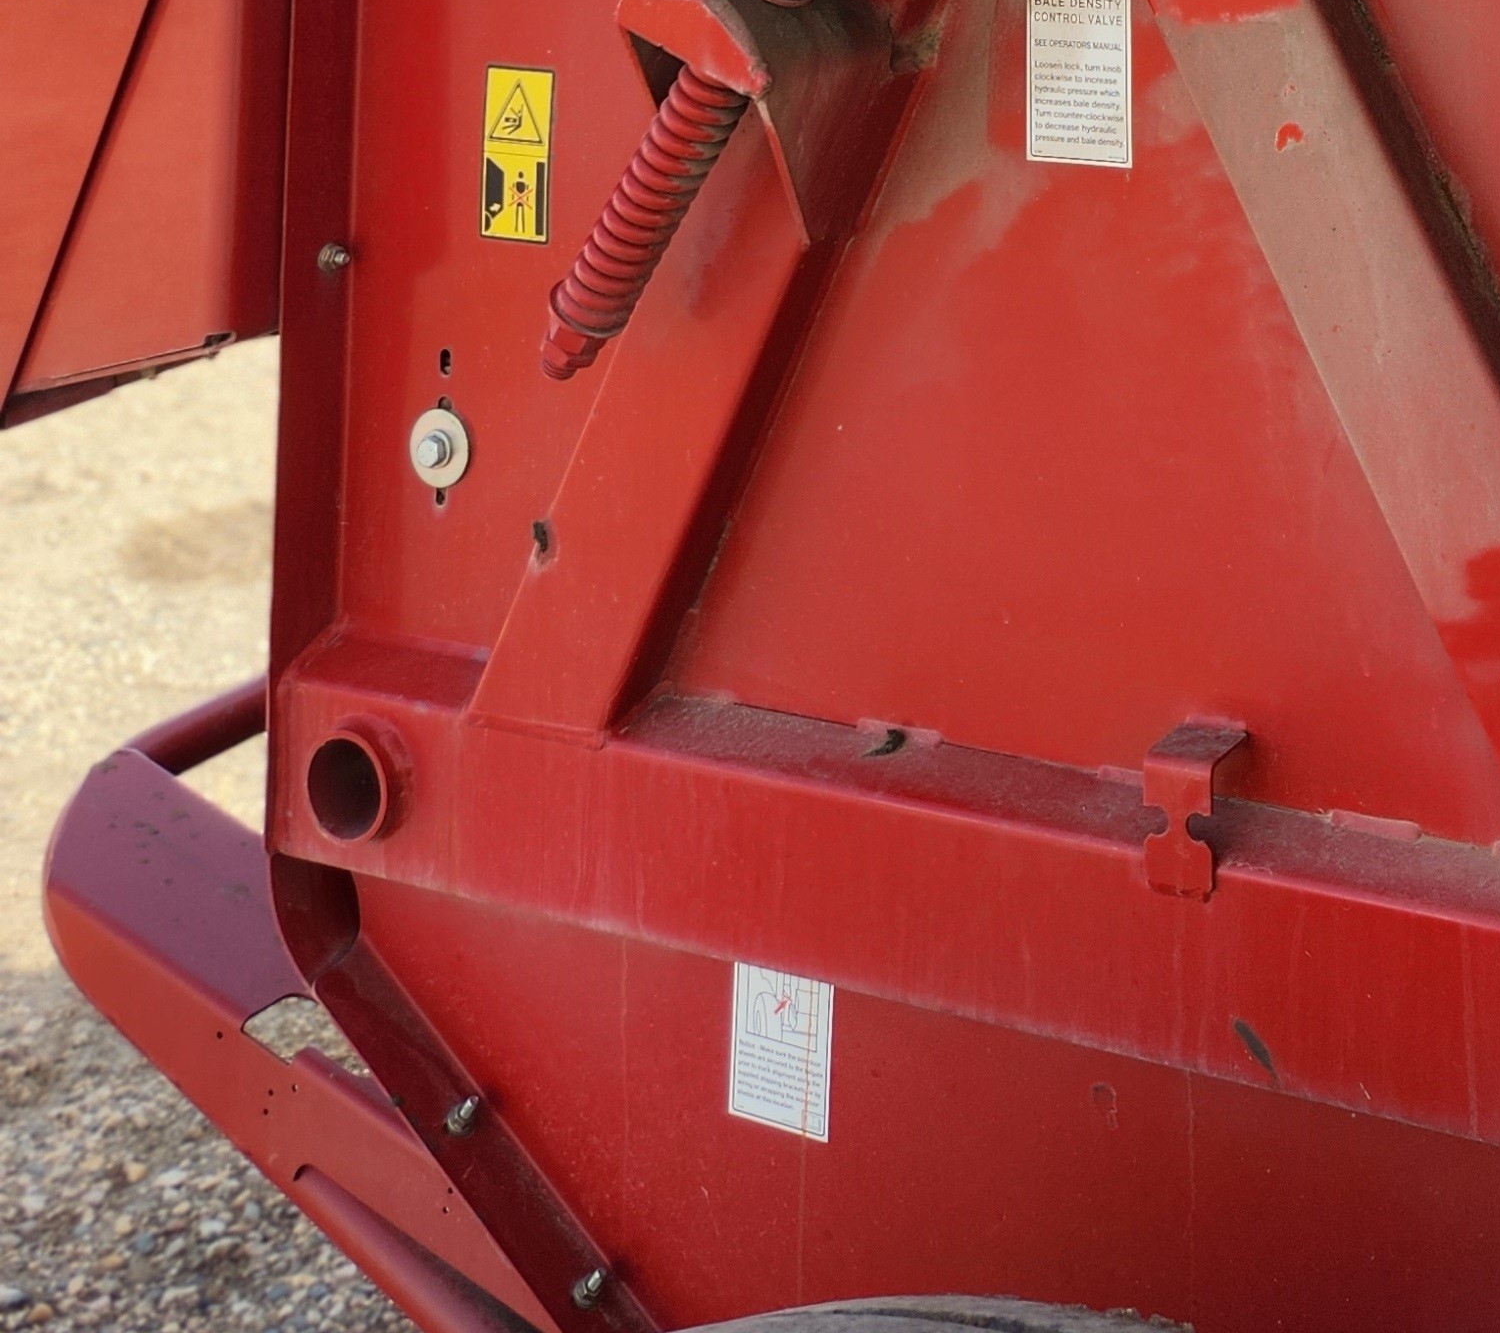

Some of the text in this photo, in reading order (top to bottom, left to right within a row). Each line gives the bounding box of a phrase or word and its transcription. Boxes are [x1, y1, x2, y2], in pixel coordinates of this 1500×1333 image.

[1034, 11, 1122, 26] CONTROL VALVE
[1034, 38, 1122, 51] SEE OPERATORS MANUAL
[1034, 60, 1121, 73] Loosen lock, turn knob
[1034, 73, 1117, 85] clockwise to increase
[1034, 85, 1066, 94] hydraulic
[1100, 89, 1120, 97] which
[1034, 98, 1121, 112] increases bale density.
[1034, 108, 1124, 122] Turn counter-clockwise
[1034, 121, 1117, 134] to decrease hydraulic
[1035, 134, 1065, 143] pressure
[1067, 136, 1080, 144] and
[1081, 136, 1096, 145] bale
